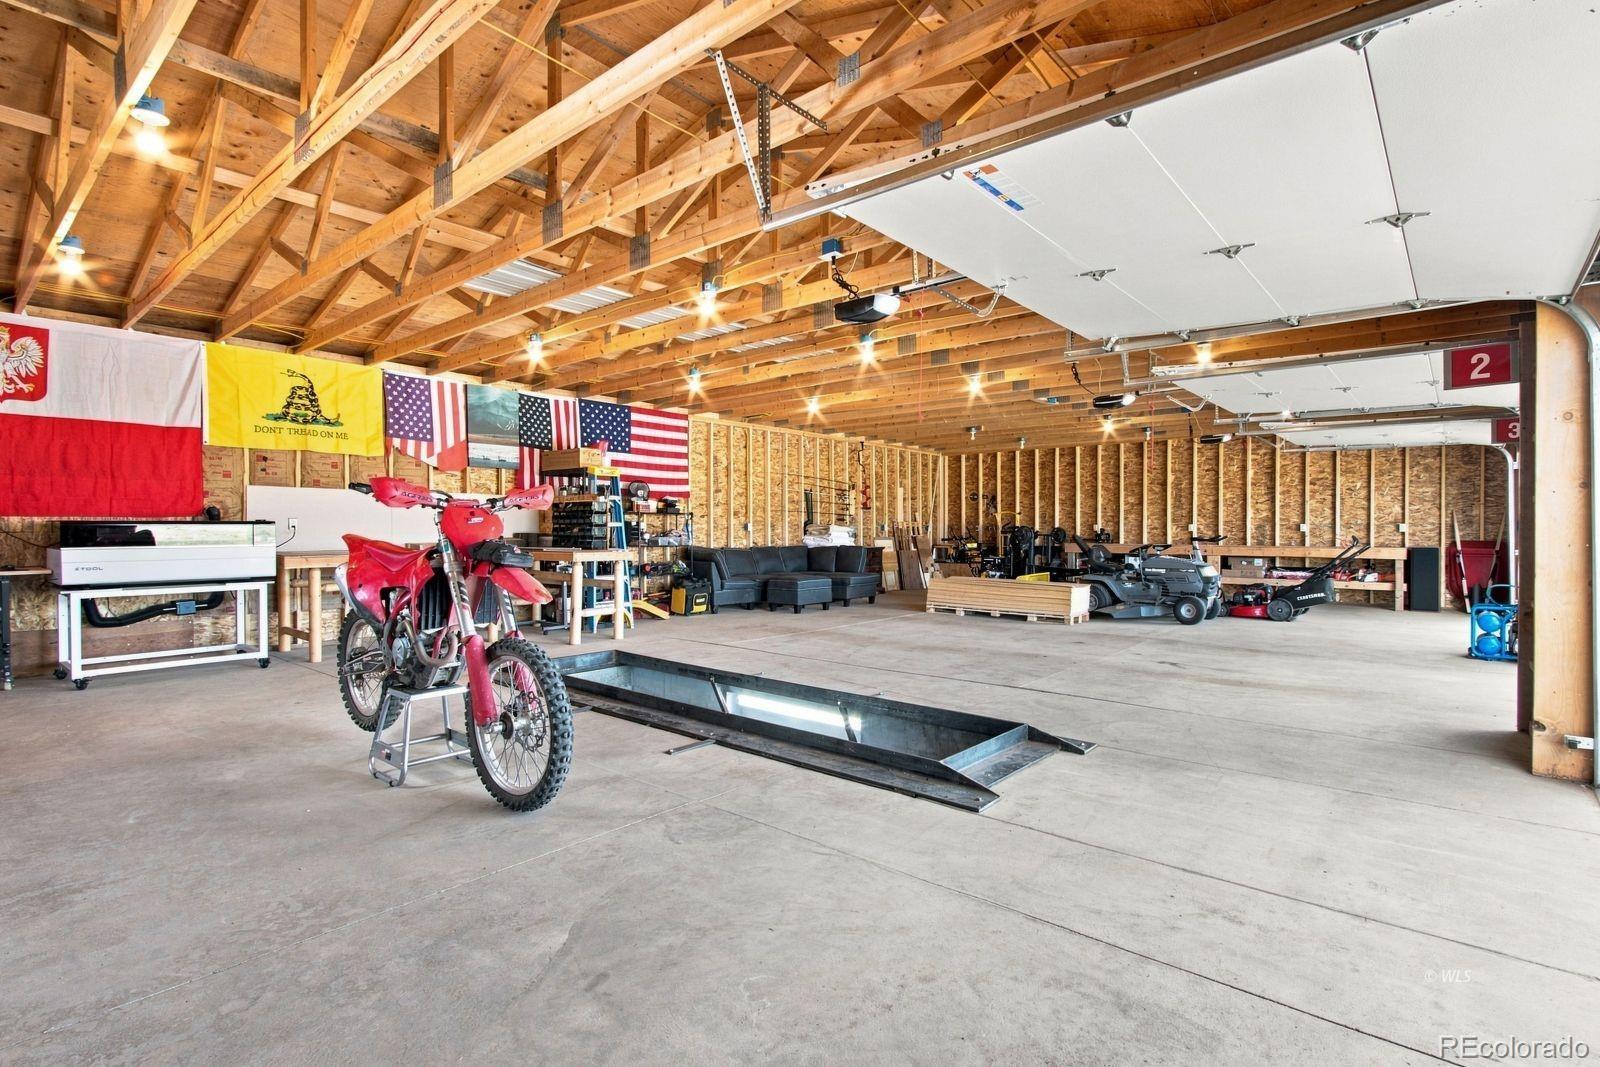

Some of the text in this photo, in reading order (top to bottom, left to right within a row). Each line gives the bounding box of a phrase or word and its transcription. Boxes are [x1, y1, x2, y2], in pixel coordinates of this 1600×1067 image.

[1470, 353, 1491, 380] 2
[287, 427, 318, 437] TREAD
[320, 430, 334, 439] ON
[336, 432, 349, 440] ME
[1508, 422, 1520, 439] 3
